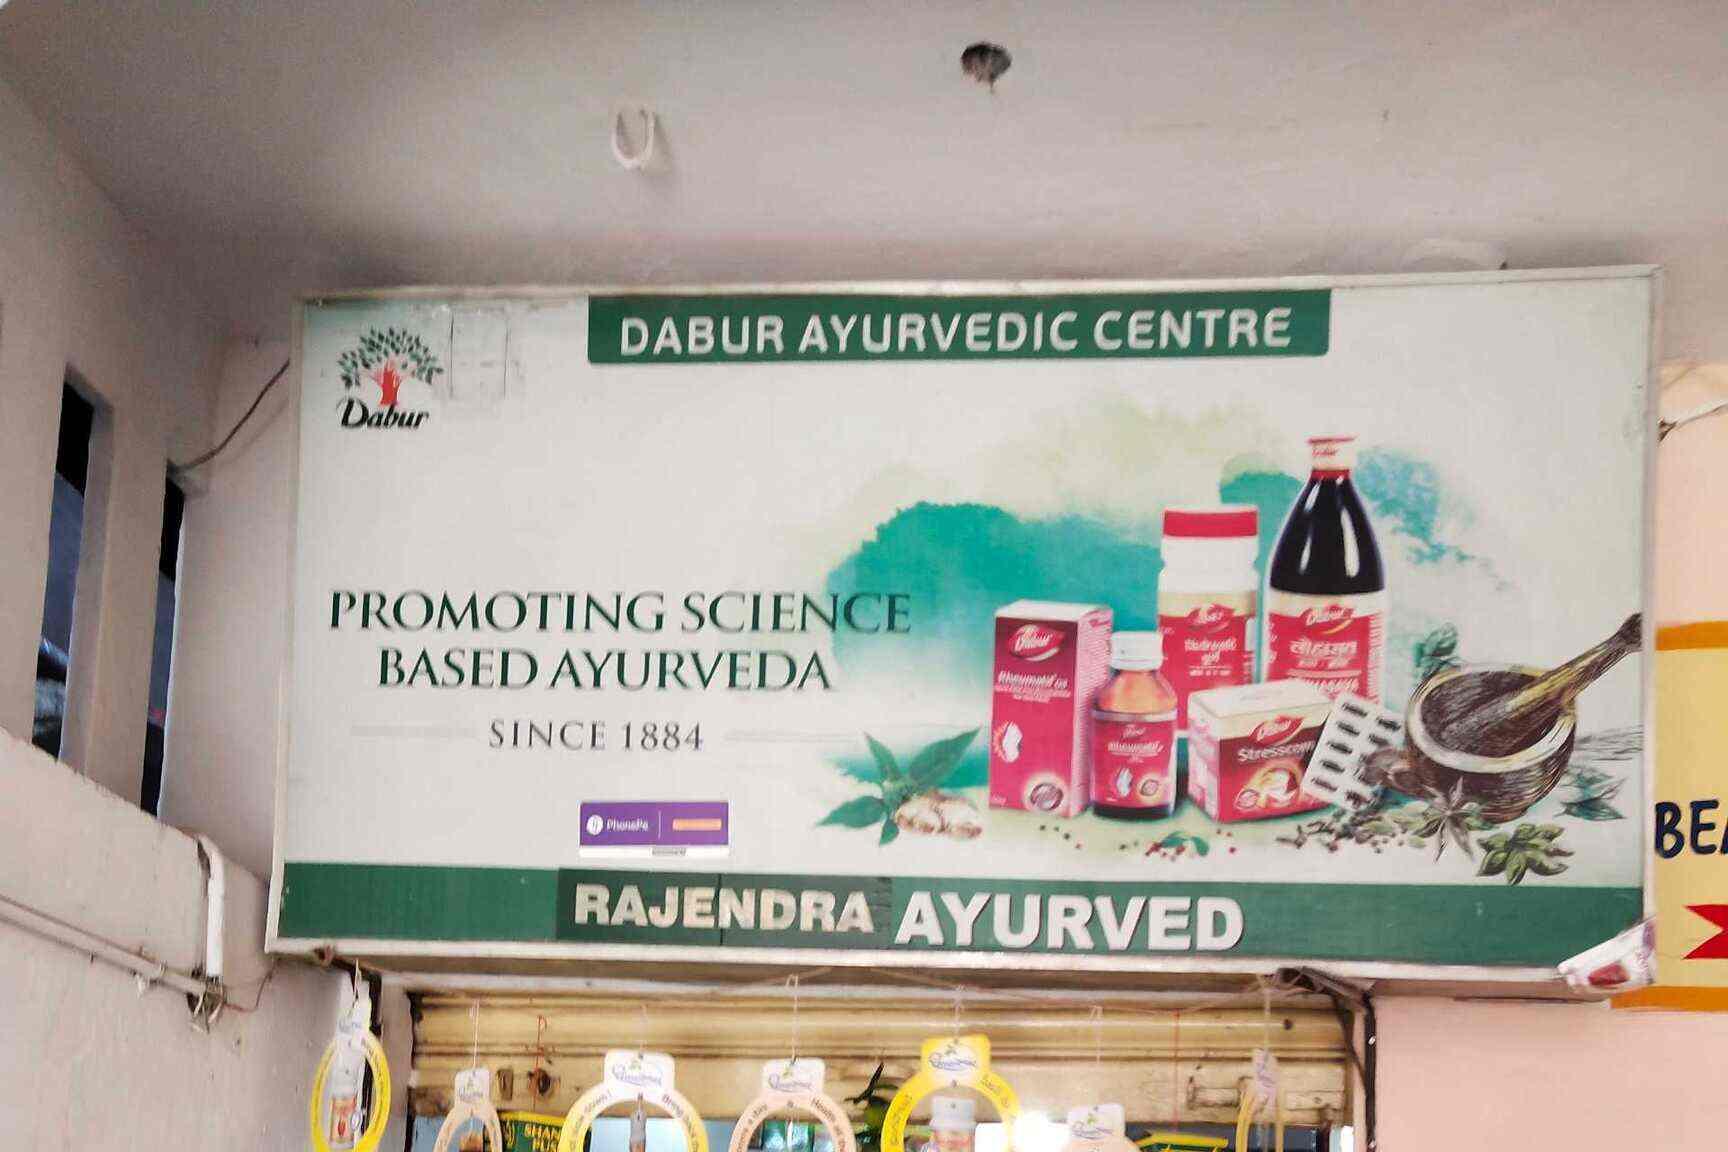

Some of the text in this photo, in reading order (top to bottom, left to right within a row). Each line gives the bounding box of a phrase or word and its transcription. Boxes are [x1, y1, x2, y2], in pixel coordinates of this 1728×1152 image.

[620, 306, 1292, 356] DABUR AYURVEDIC CENTRE
[336, 397, 430, 430] Dabur
[329, 590, 912, 634] PROMOTING SCIENCE
[377, 647, 834, 690] BASED AYURVEDA
[488, 719, 704, 752] SINCE 1884
[606, 818, 649, 832] PhonePe
[1654, 799, 1728, 860] BE
[574, 883, 1246, 952] RAJENDRA AYURVED
